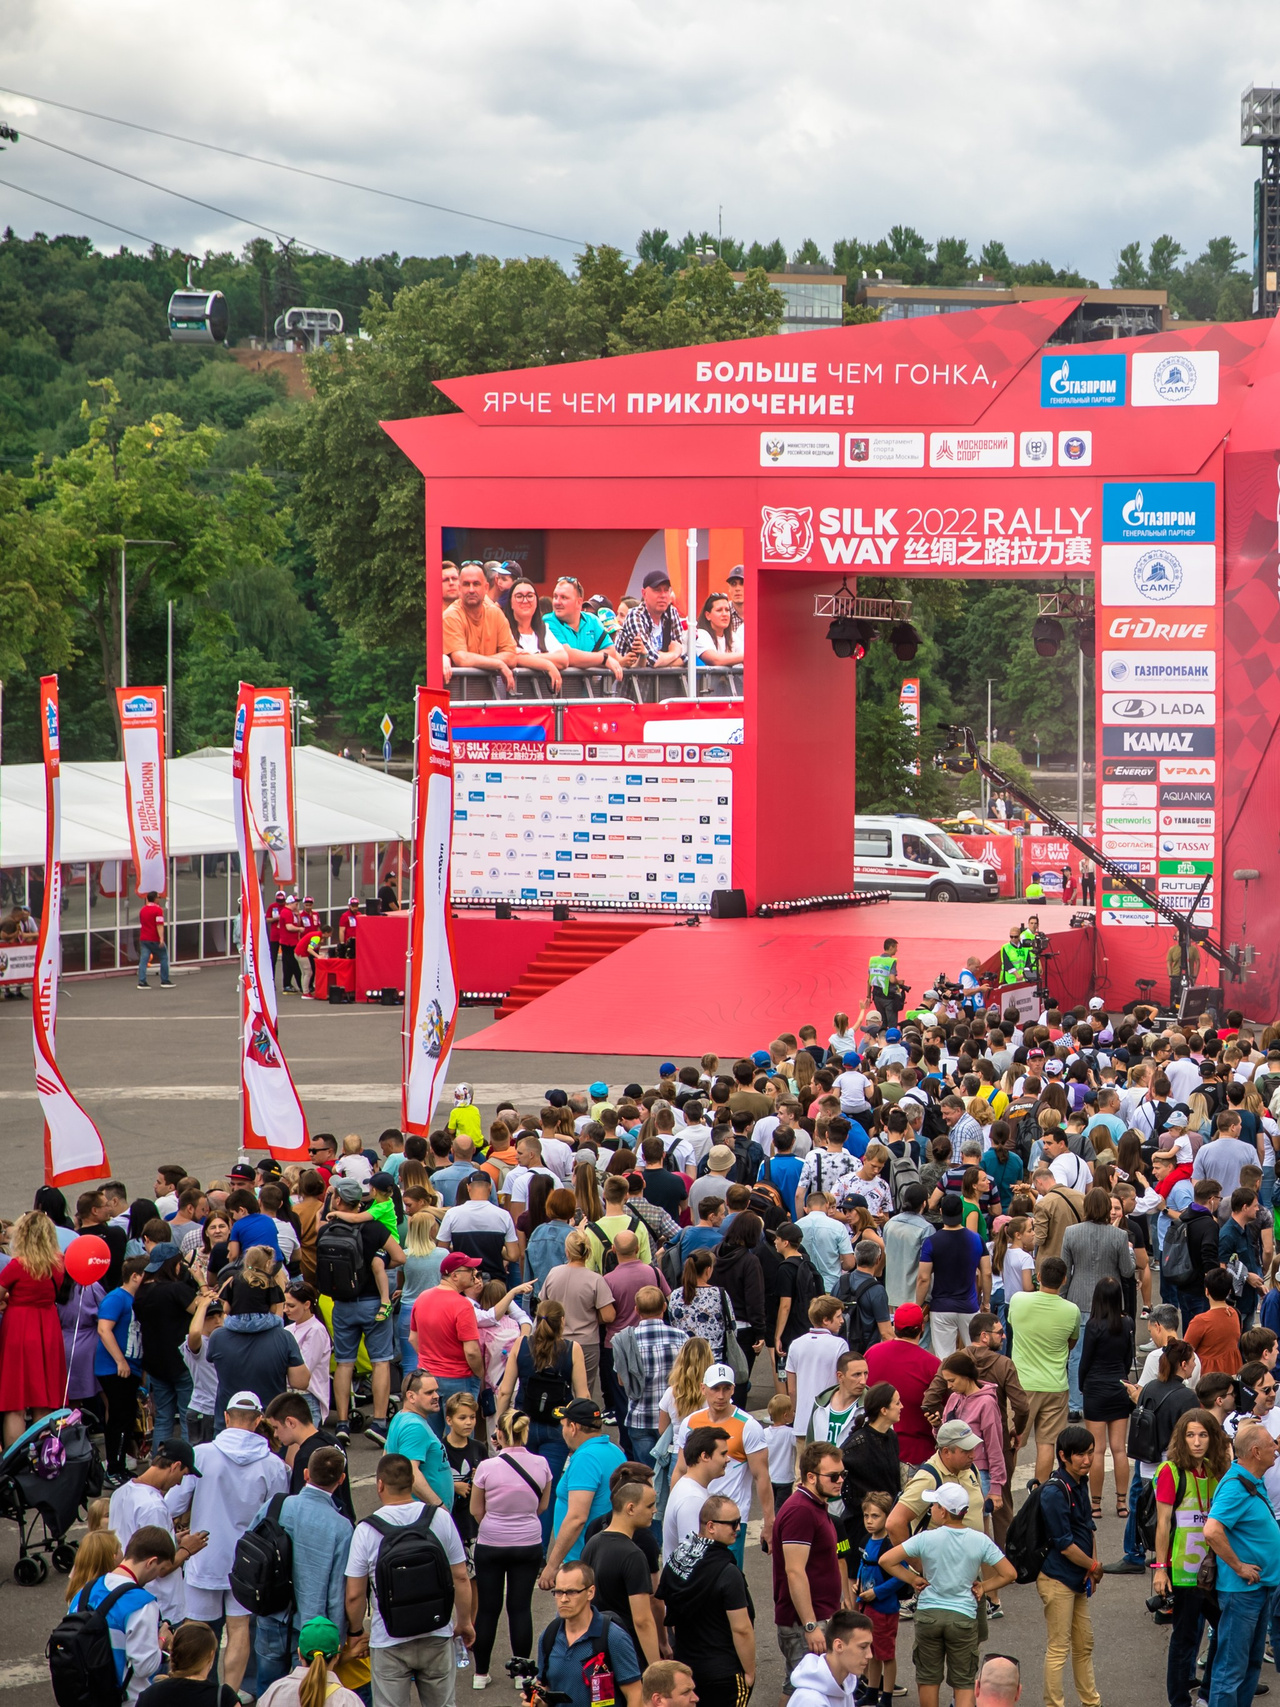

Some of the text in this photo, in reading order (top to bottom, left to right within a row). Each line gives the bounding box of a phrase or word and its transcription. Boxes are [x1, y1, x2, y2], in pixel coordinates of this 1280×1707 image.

[696, 361, 997, 389] БОЛЬШЕ ЧЕМ ГОНКА,
[1069, 380, 1116, 394] ГАЗПРОМ
[1159, 385, 1190, 394] CAMF
[483, 392, 855, 415] ЯРЧЕ ЧЕМ ПРИКЛЮЧЕНИЕ!
[873, 438, 913, 446] Департамент
[957, 437, 1008, 450] МОСКОВСКИЙ
[957, 450, 981, 461] СПОРТ
[819, 507, 1093, 536] SILK 2022 RALLY
[1144, 511, 1196, 526] ГАЗПРОМ
[1123, 529, 1166, 537] ГЕНЕРАЛЬНЫЙ
[819, 537, 899, 565] WAY
[903, 537, 1092, 566] 丝绸之路拉力赛
[1141, 584, 1175, 592] CAMF
[1134, 666, 1208, 676] ГАЗПРОМБАНК
[1161, 704, 1205, 715] LADA
[1124, 732, 1194, 751] KAMAZ
[467, 743, 545, 751] SILK 2022 RALLY
[467, 752, 490, 760] WAY
[1162, 792, 1212, 801] AQUANIKA
[1105, 816, 1152, 825] greenworks
[1047, 843, 1070, 852] SILK
[1176, 842, 1211, 851] TASSAY
[1047, 851, 1069, 860] WAY
[1141, 863, 1150, 871] 24
